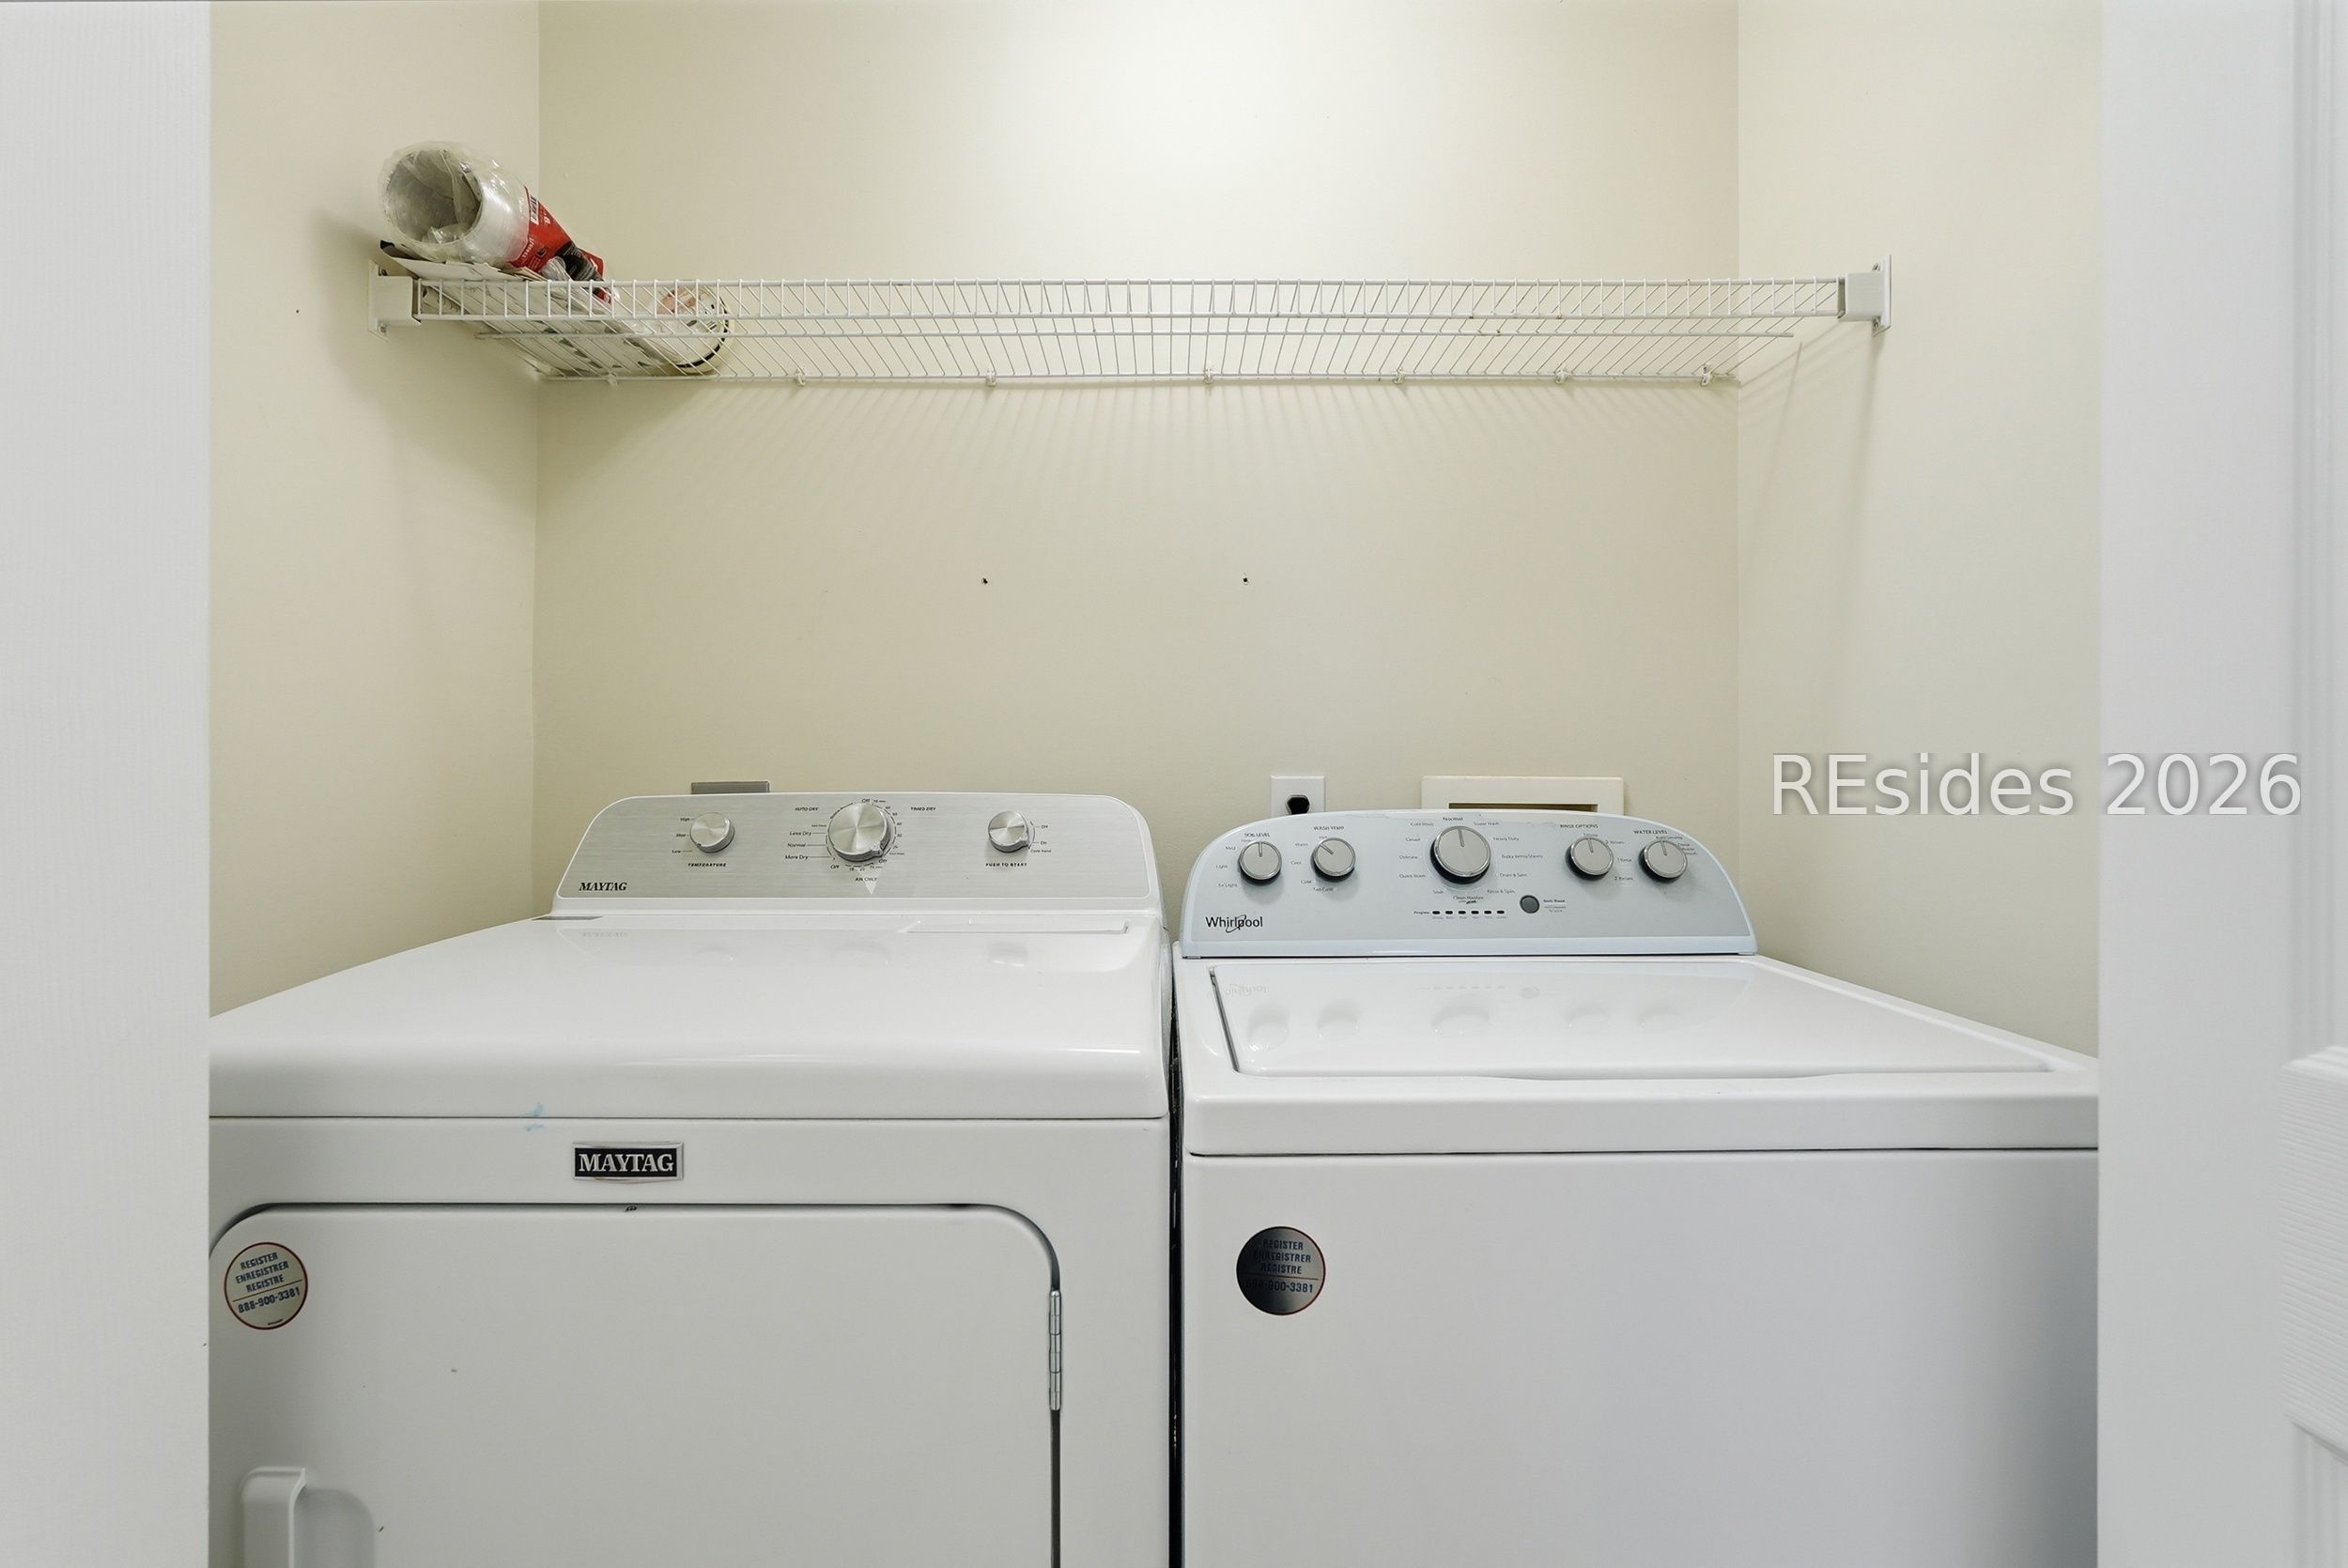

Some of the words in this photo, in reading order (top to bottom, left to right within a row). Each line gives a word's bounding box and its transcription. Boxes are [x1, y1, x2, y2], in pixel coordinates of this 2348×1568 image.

[579, 882, 627, 891] MAYTAG
[1205, 915, 1263, 932] Whirlpool
[579, 1153, 674, 1173] MAYTAG
[240, 1252, 279, 1270] REGISTER
[235, 1260, 289, 1284] ENREGISTRER
[245, 1274, 285, 1293] REGISTRE
[238, 1286, 301, 1314] 888-900-3381
